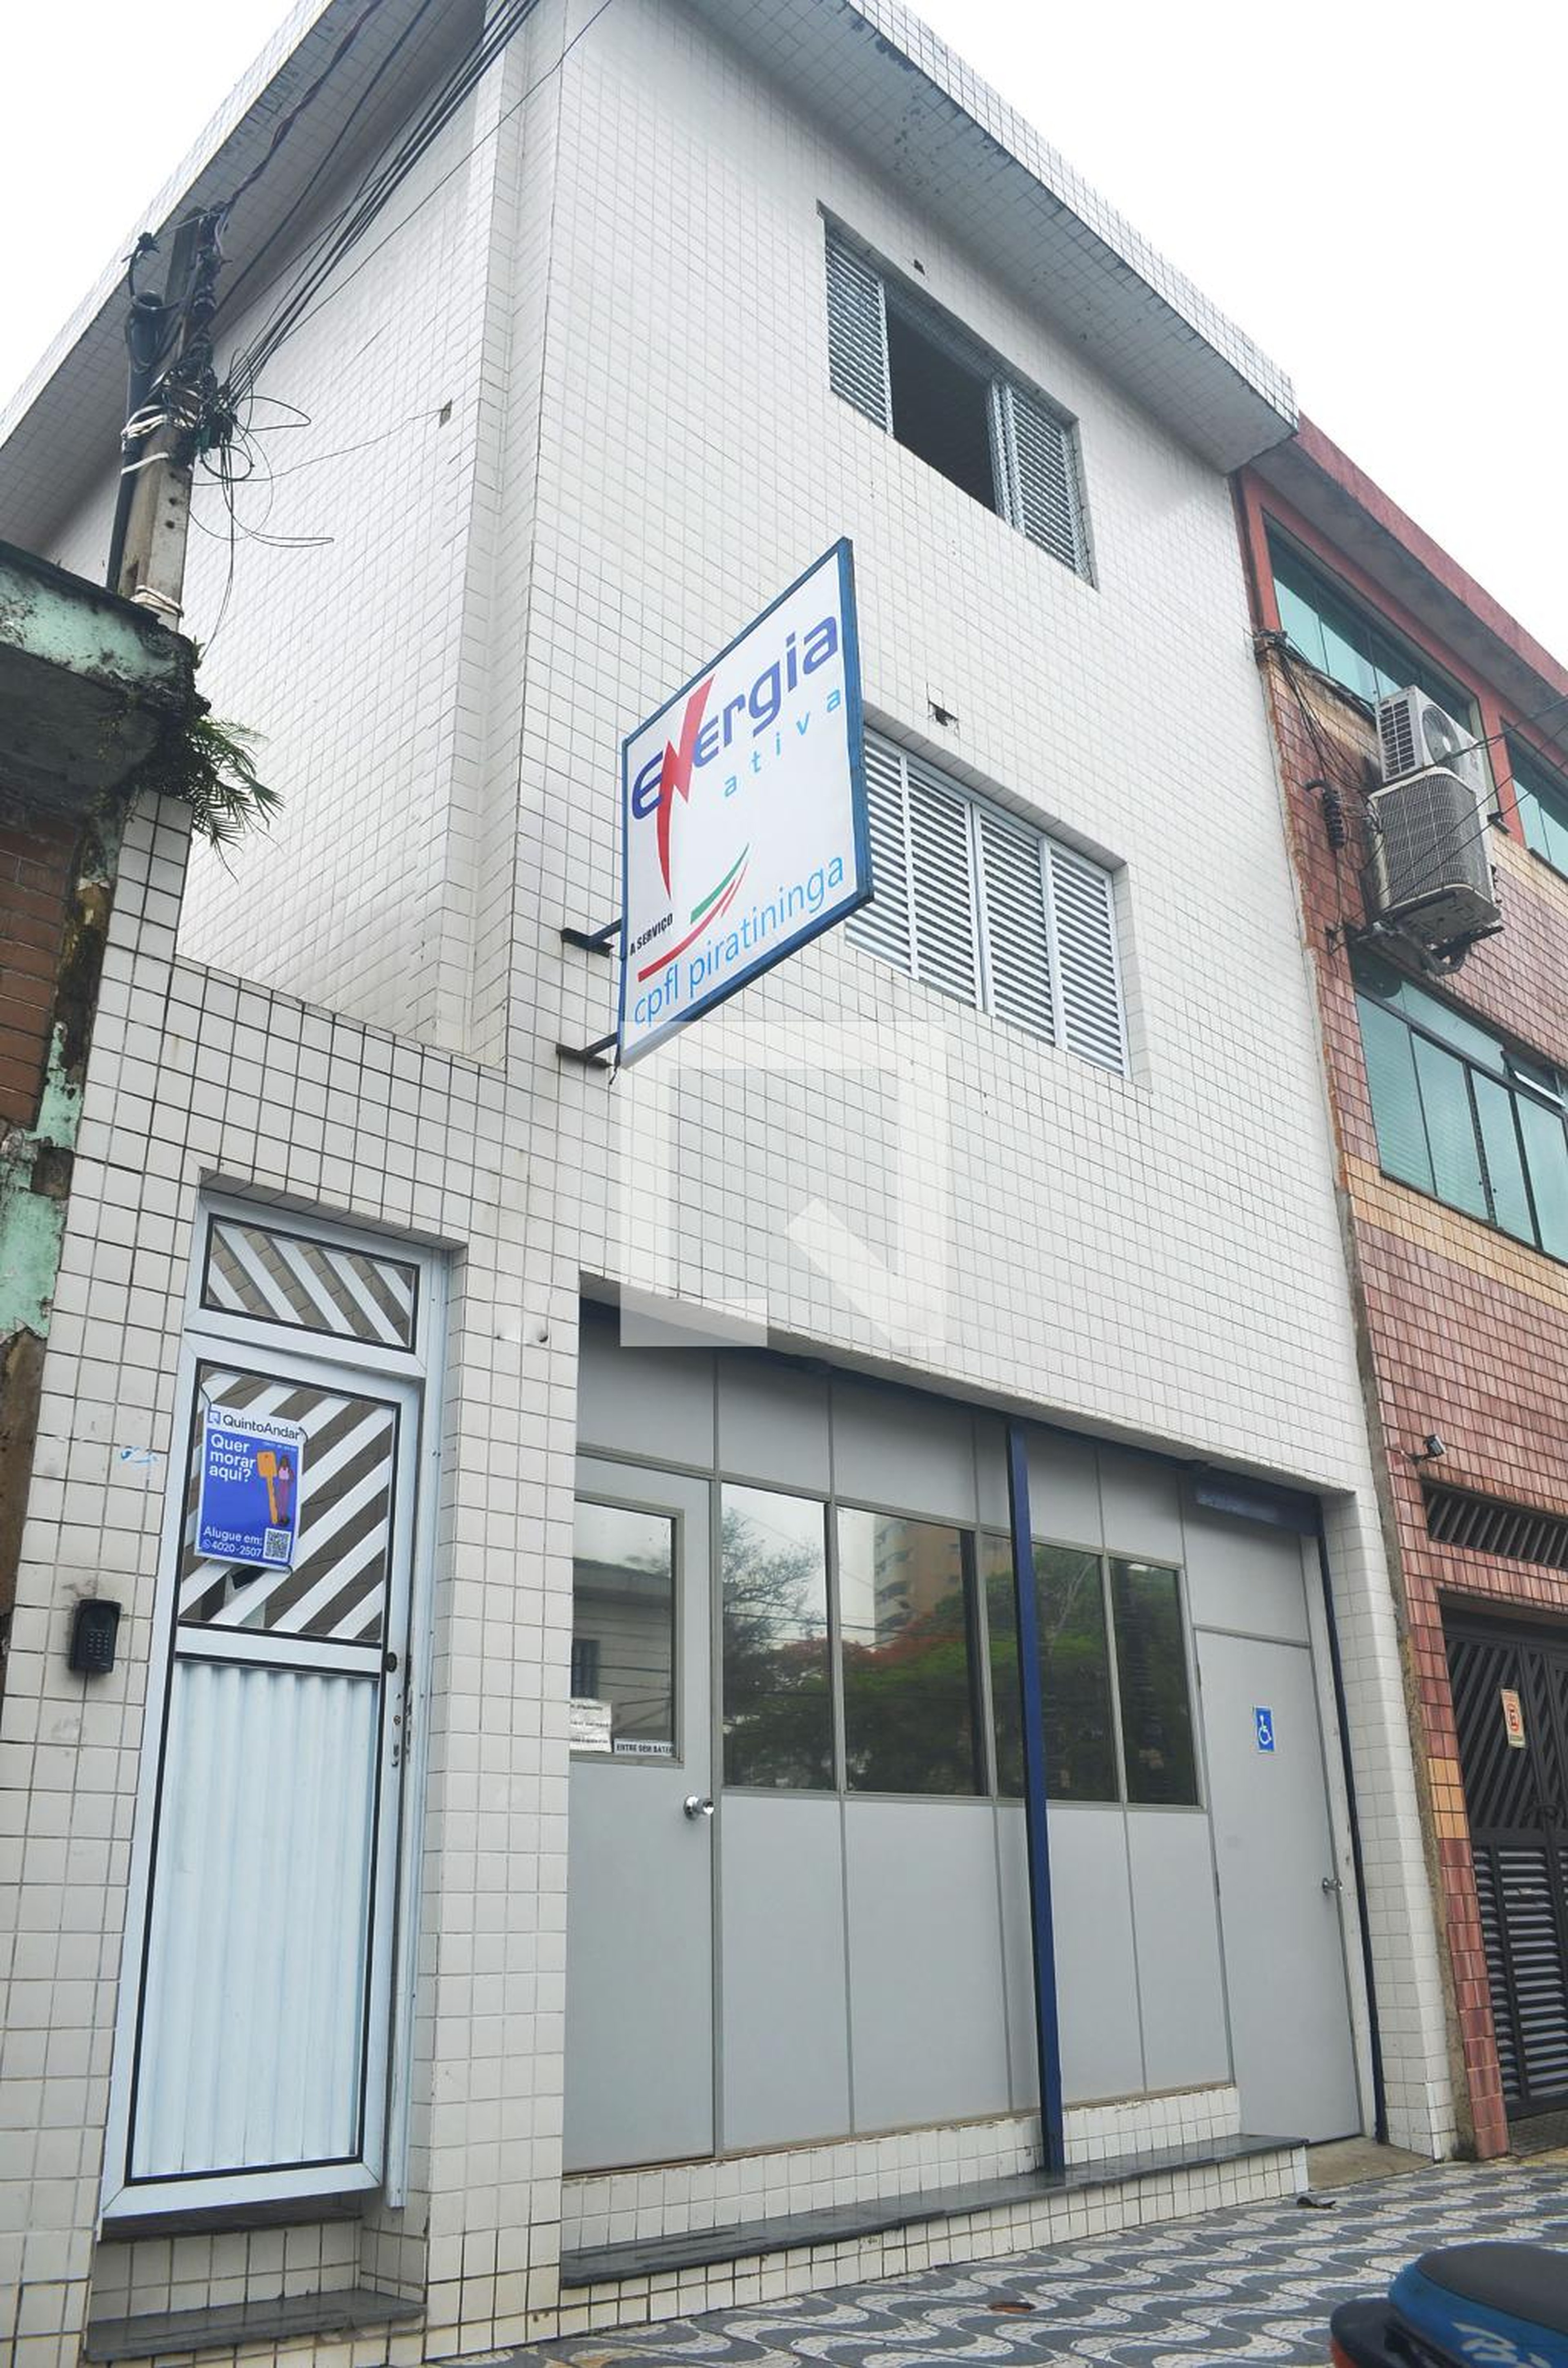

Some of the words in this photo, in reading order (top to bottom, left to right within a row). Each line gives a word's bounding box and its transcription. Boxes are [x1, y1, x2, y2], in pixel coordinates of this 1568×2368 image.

[724, 687, 842, 797] ativa
[634, 963, 678, 1025] cpfl
[689, 854, 844, 989] piratininga
[630, 943, 635, 956] A
[223, 1414, 299, 1440] QuintoAndar
[211, 1434, 250, 1454] Quer
[210, 1451, 256, 1469] morar
[209, 1464, 251, 1482] aqui?
[204, 1526, 242, 1542] Alugue
[244, 1535, 263, 1546] em:
[212, 1541, 262, 1556] 4020-2507
[616, 1744, 637, 1753] ENTRE
